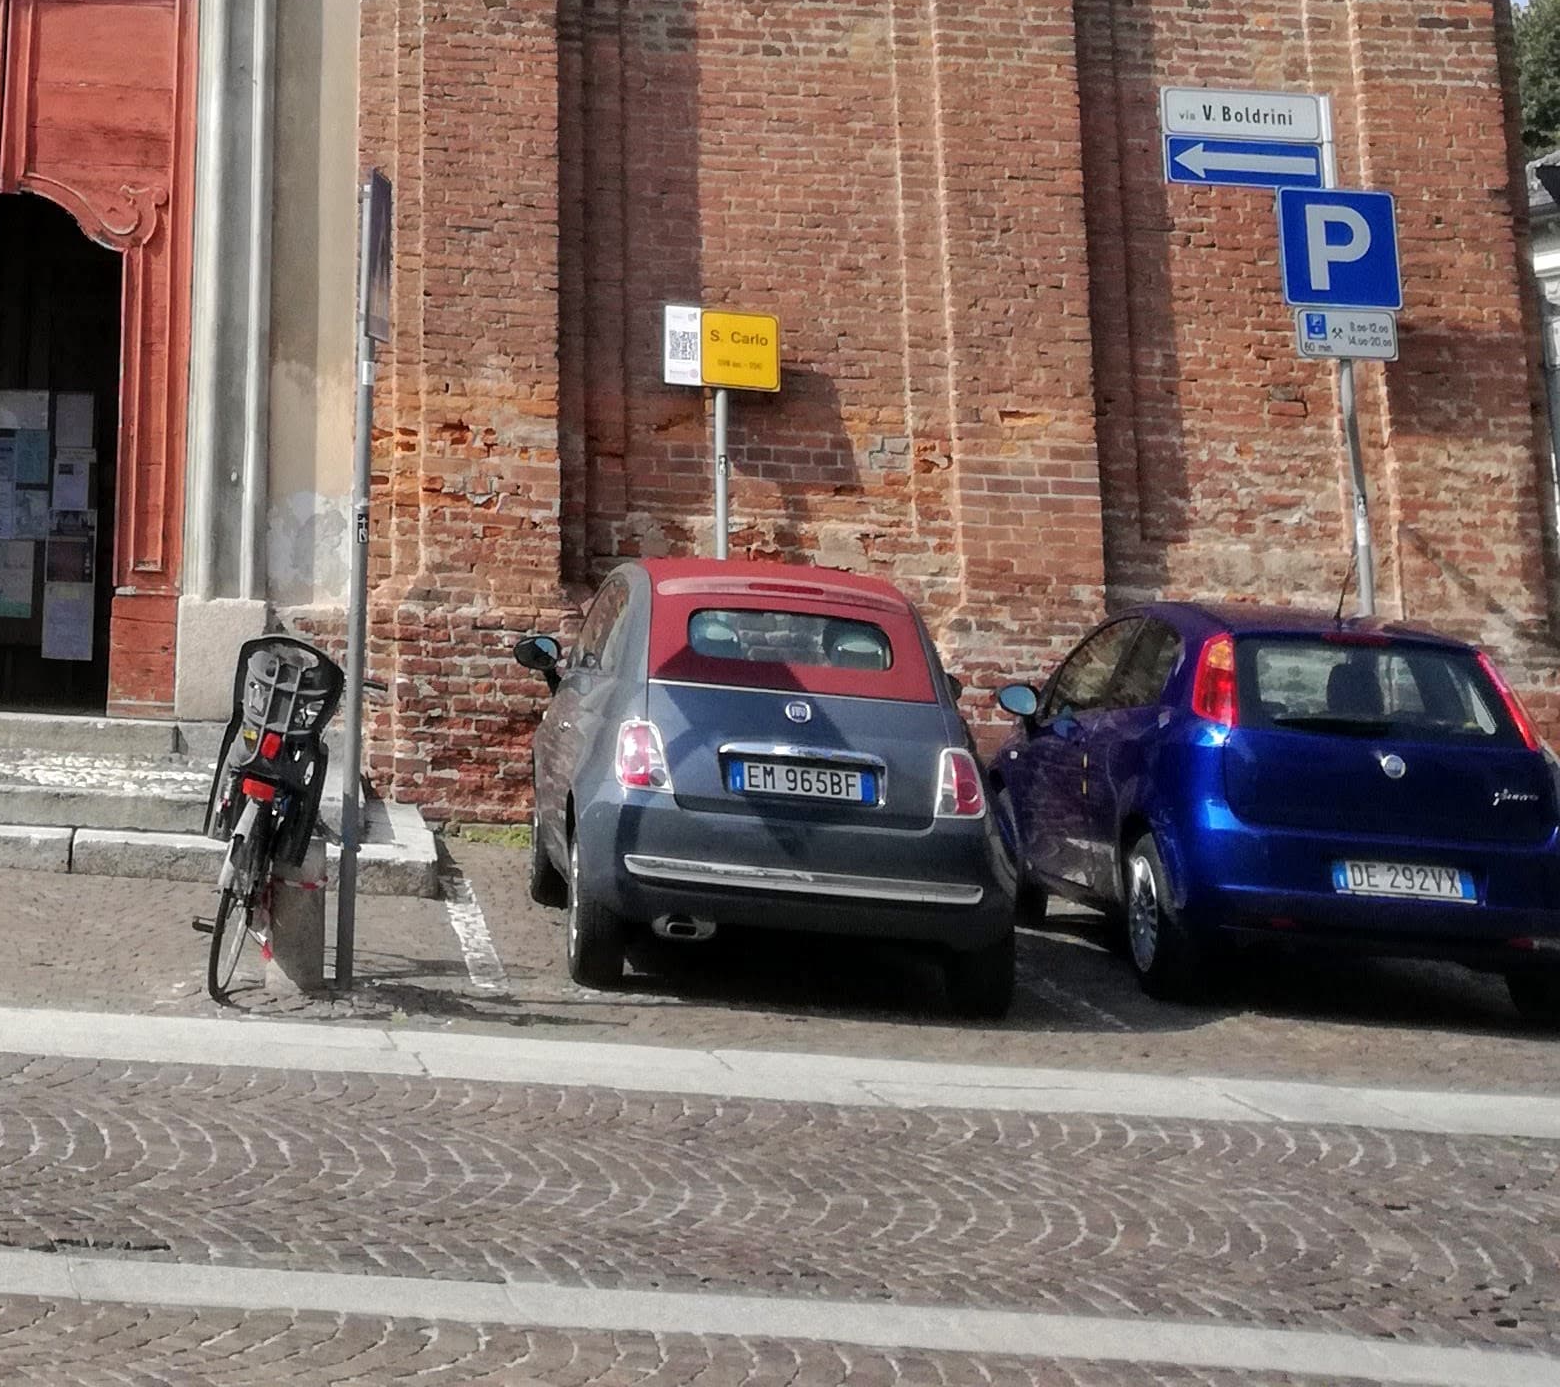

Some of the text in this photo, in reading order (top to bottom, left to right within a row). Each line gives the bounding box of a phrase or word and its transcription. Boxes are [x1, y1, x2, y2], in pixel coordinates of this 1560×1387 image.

[1179, 104, 1293, 126] via V. Boldrini
[1304, 203, 1372, 291] P
[710, 329, 769, 347] S. Carlo
[747, 765, 776, 790] EM
[785, 768, 857, 797] 965BF
[1349, 863, 1379, 888] DE
[1387, 865, 1461, 894] 292VX
